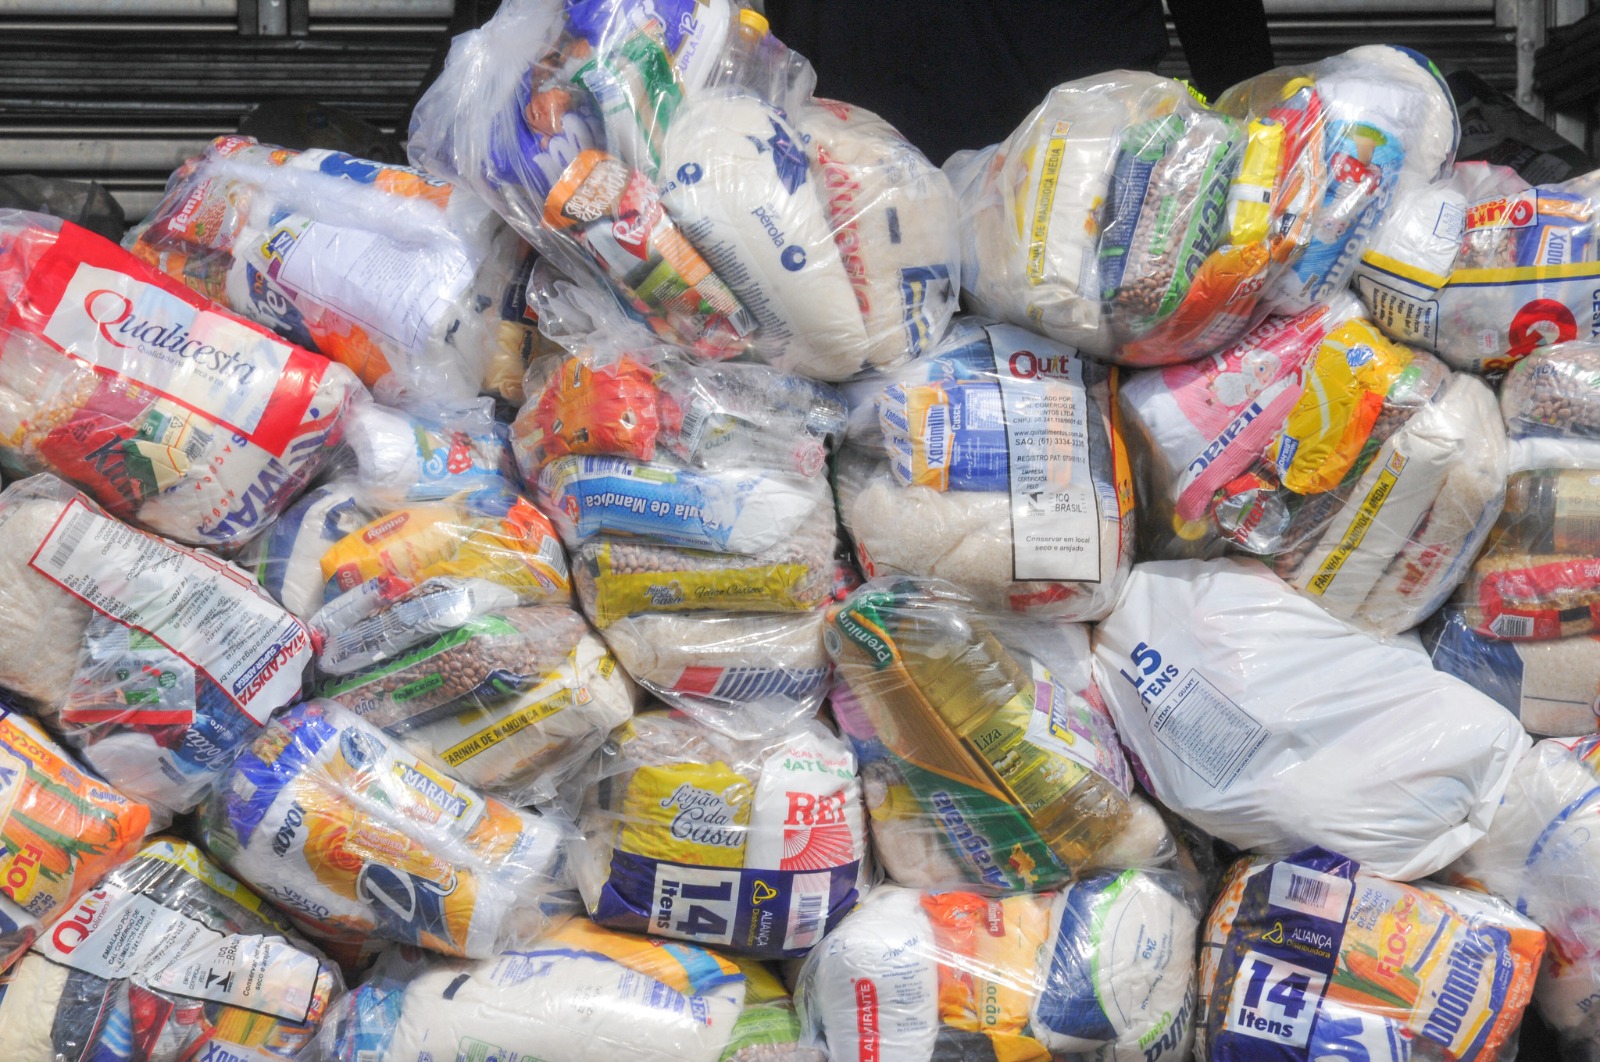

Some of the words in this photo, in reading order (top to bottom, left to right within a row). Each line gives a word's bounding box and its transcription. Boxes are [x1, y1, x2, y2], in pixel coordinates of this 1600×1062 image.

[680, 13, 698, 36] 12
[751, 203, 788, 248] pérola
[84, 289, 257, 387] Qualicesta
[1009, 350, 1069, 379] Quit
[649, 499, 669, 517] de
[1060, 546, 1084, 554] arejado
[237, 630, 306, 705] ATACADISTA
[254, 646, 276, 669] SUPER
[235, 665, 256, 688] ADEGA
[1157, 704, 1172, 721] ITENS
[481, 731, 497, 746] DE
[974, 726, 1004, 751] Liza
[402, 769, 467, 819] MARATÁ
[661, 784, 721, 809] feijão
[705, 810, 729, 826] da
[783, 790, 846, 826] REI
[131, 908, 140, 918] DE
[284, 885, 329, 916] ULTRA
[656, 879, 680, 930] Itens
[675, 880, 733, 937] 14
[133, 914, 145, 931] LTDA
[757, 909, 773, 948] ALIANÇA
[1357, 916, 1367, 928] DE
[101, 923, 124, 959] EMBALADO
[1141, 937, 1157, 960] 2kg
[1291, 926, 1333, 949] ALIANÇA
[243, 959, 257, 996] Conservar
[254, 973, 263, 990] seco
[1242, 959, 1314, 1020] 14
[860, 983, 873, 1050] ALMIRANTE
[1238, 1008, 1294, 1039] Itens
